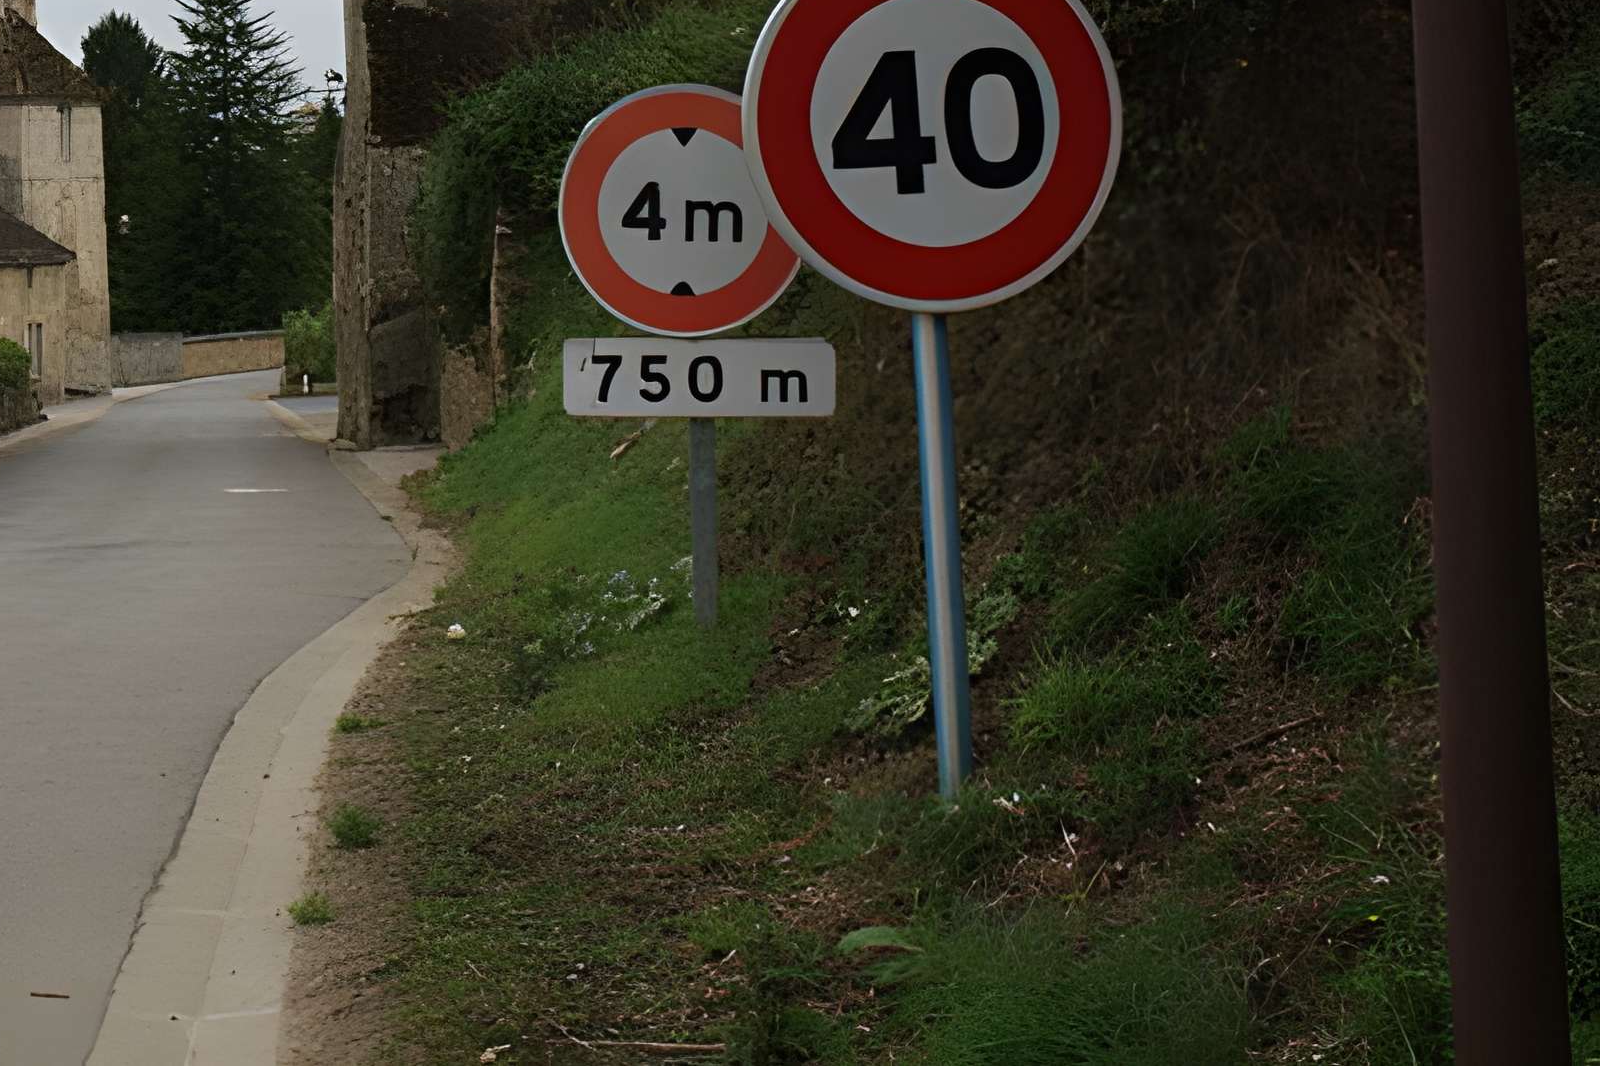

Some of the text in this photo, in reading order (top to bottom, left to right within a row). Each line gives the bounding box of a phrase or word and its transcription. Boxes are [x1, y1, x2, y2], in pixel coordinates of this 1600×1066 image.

[831, 47, 1045, 194] 40
[591, 354, 808, 403] 750 m
